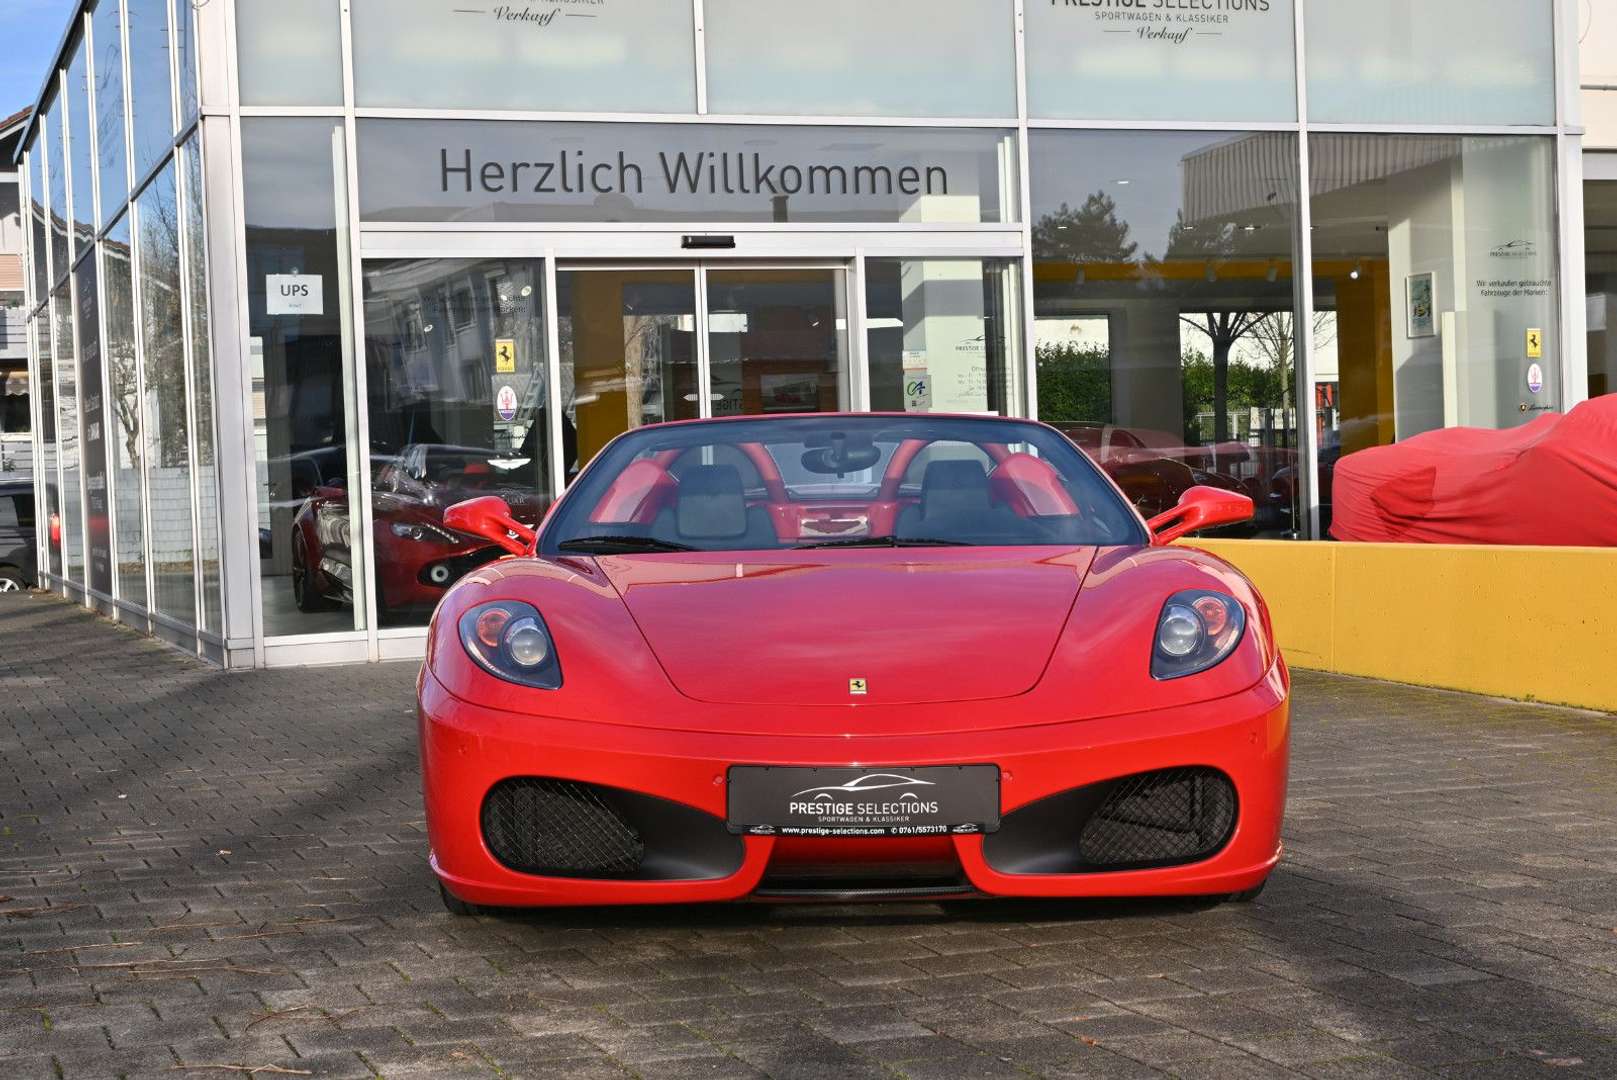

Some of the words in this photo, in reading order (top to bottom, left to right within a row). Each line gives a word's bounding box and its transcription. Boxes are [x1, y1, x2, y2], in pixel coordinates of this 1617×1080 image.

[493, 6, 561, 26] Verkauf
[1095, 11, 1162, 22] SPORTWAGEN
[1165, 13, 1172, 22] &
[1175, 13, 1228, 24] KLASSIKER
[1136, 26, 1193, 44] Verkauf
[441, 148, 643, 194] Herzlich
[659, 151, 948, 195] Willkommen
[280, 284, 309, 297] UPS
[789, 802, 854, 815] PRESTIGE
[857, 801, 939, 815] SELECTIONS
[872, 815, 910, 823] KLASSIKER
[781, 827, 885, 836] www.prestige-selections.com
[899, 825, 947, 834] 0761/5573170
